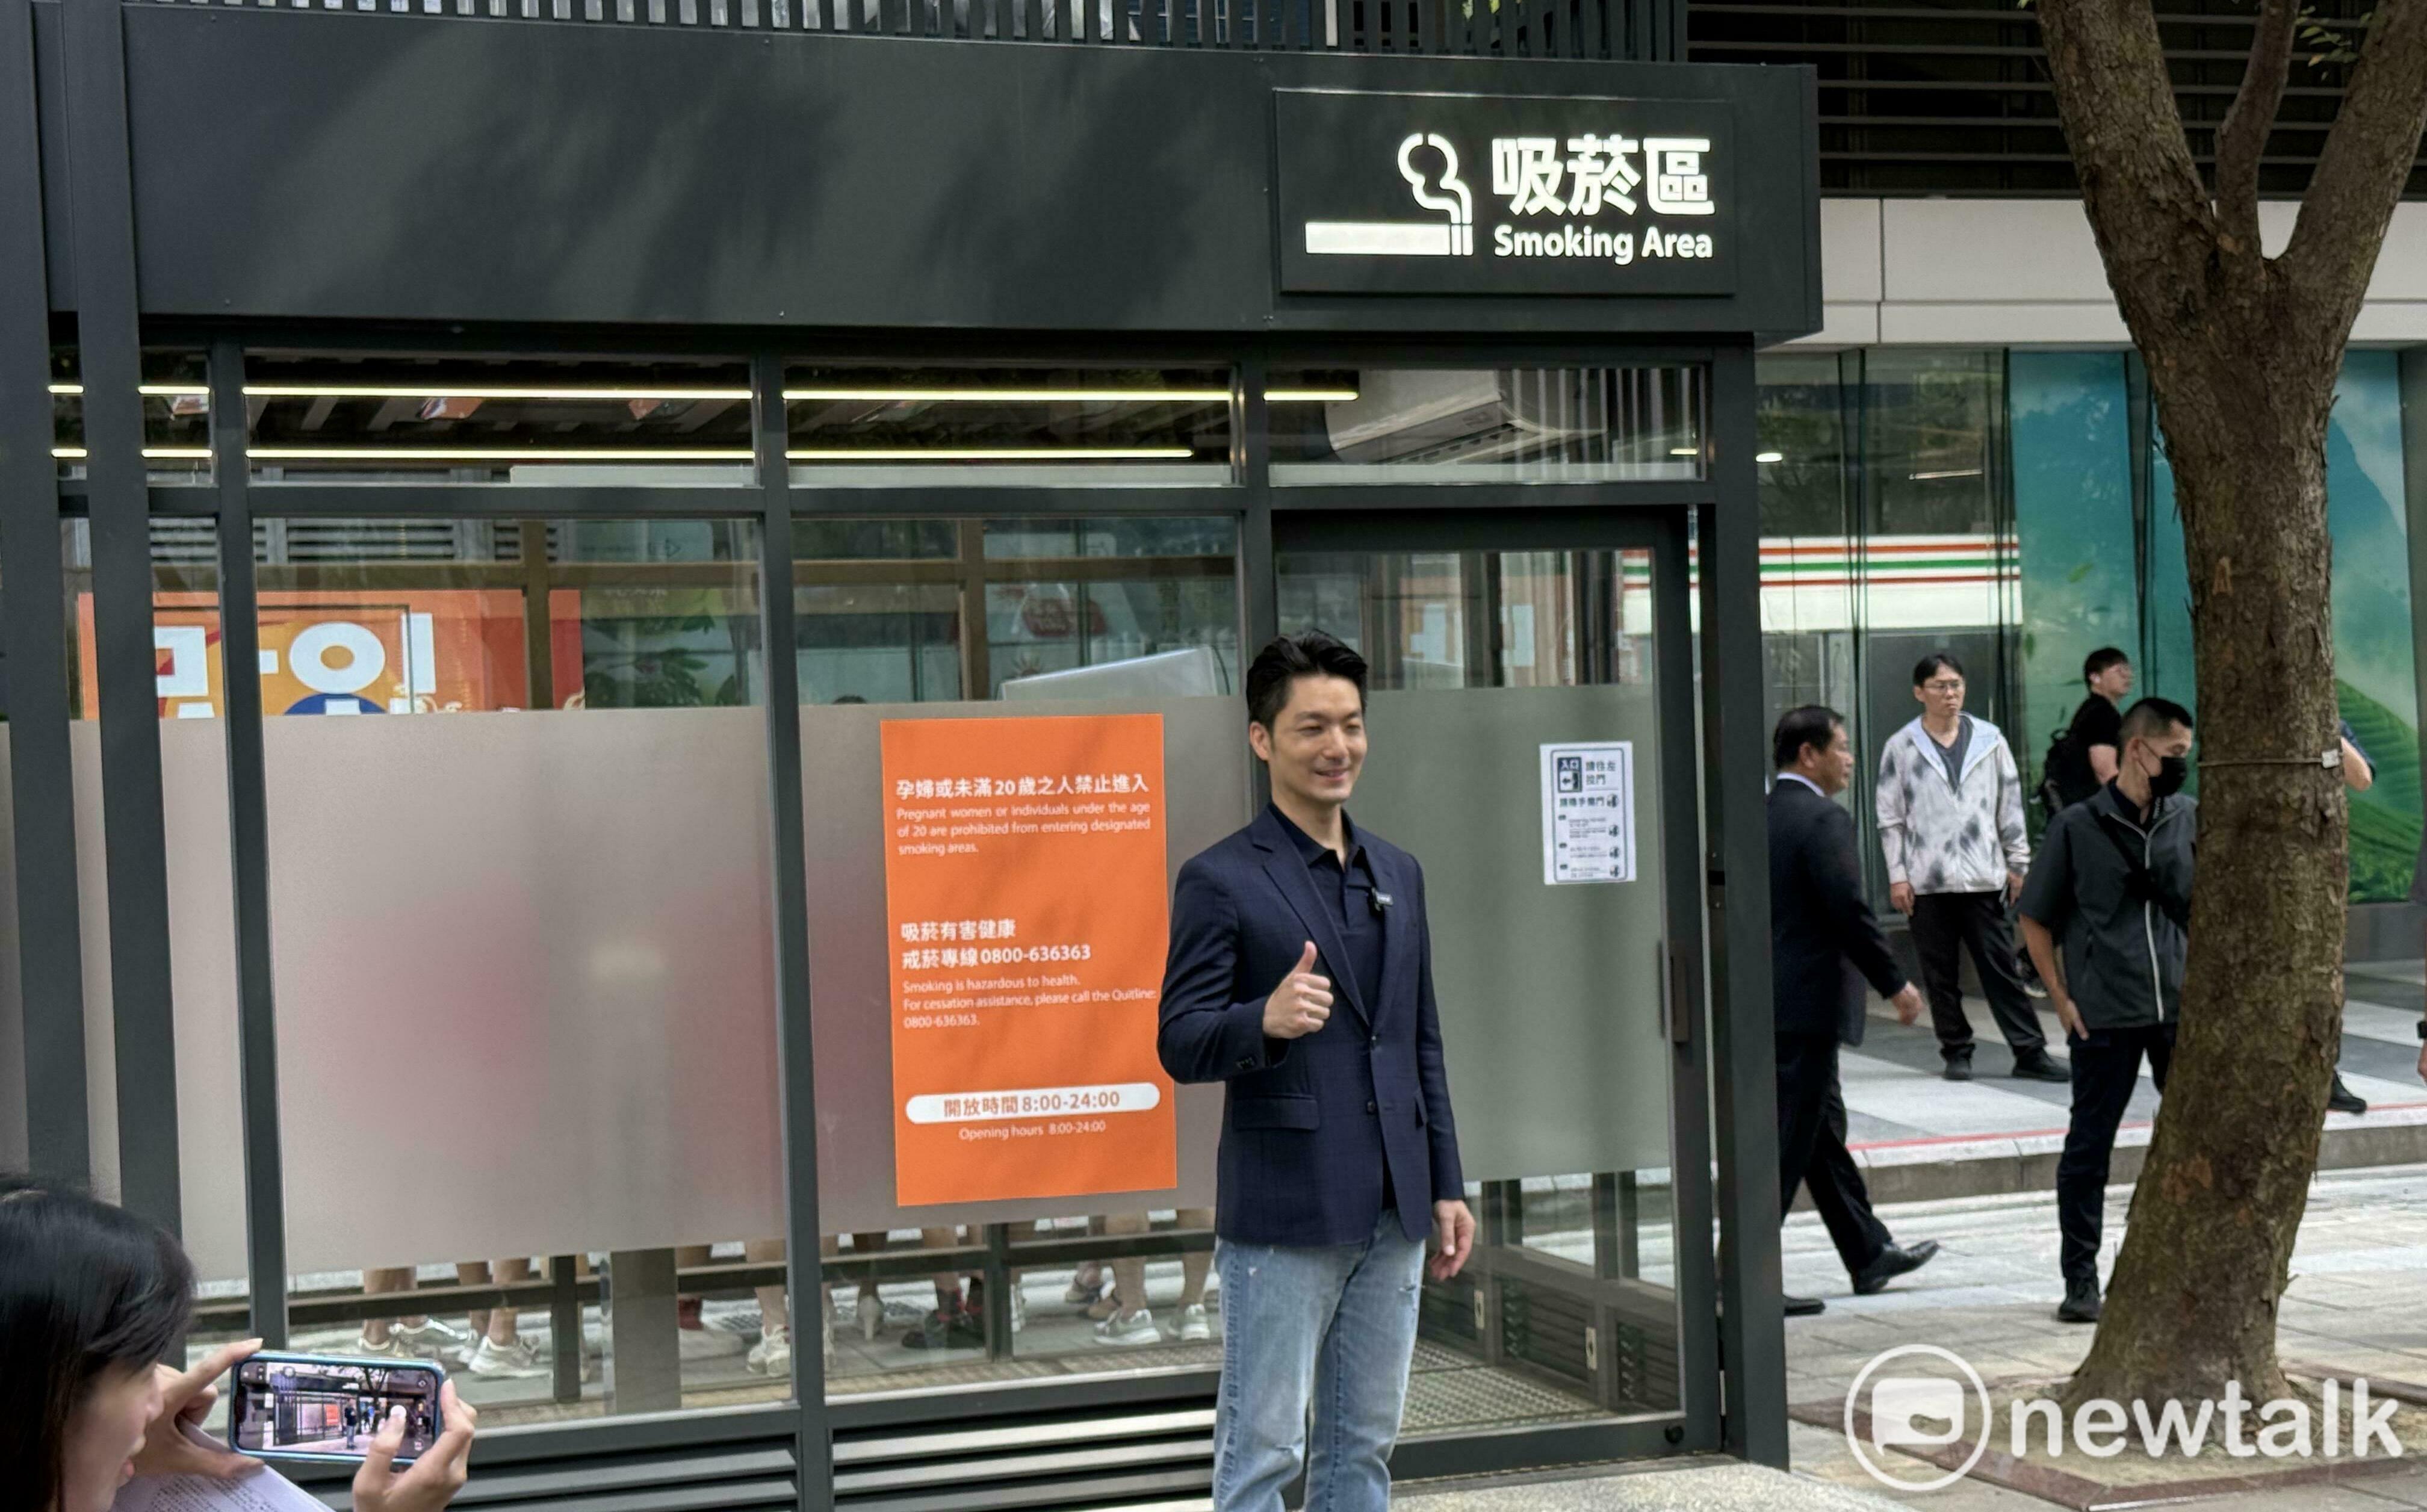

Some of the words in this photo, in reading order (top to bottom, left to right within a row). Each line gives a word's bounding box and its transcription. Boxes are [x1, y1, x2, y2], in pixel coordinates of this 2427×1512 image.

[1492, 134, 1715, 216] 吸菸區
[1493, 225, 1634, 265] Smoking
[1641, 226, 1713, 259] Area
[896, 773, 1149, 800] 孕婦或未滿20歲之人禁止進入
[897, 808, 946, 822] Pregnant
[950, 808, 992, 817] women
[996, 807, 1008, 816] or
[1011, 803, 1070, 816] individuals
[1073, 802, 1105, 814] under
[1108, 801, 1127, 813] the
[1130, 803, 1150, 815] age
[897, 825, 910, 838] of
[913, 825, 927, 837] 20
[930, 827, 948, 837] are
[951, 822, 1009, 838] prohibited
[1012, 821, 1038, 834] from
[1041, 820, 1088, 834] entering
[1091, 817, 1151, 833] designated
[899, 842, 946, 857] smoking
[947, 843, 979, 854] areas.
[902, 919, 1016, 942] 吸菸有害健康
[903, 980, 953, 995] Smoking
[956, 979, 966, 991] is
[967, 977, 1024, 990] hazardous
[1027, 976, 1040, 987] to
[1041, 973, 1080, 987] health.
[904, 999, 922, 1012] For
[923, 997, 974, 1010] cessation
[1035, 991, 1070, 1007] please
[1071, 990, 1090, 1003] call
[1092, 990, 1111, 1002] the
[944, 1091, 1120, 1117] 開放時間8:00-24:00
[958, 1127, 1009, 1141] Opening
[1011, 1124, 1044, 1136] hours
[1048, 1120, 1106, 1136] 8:00-24:00
